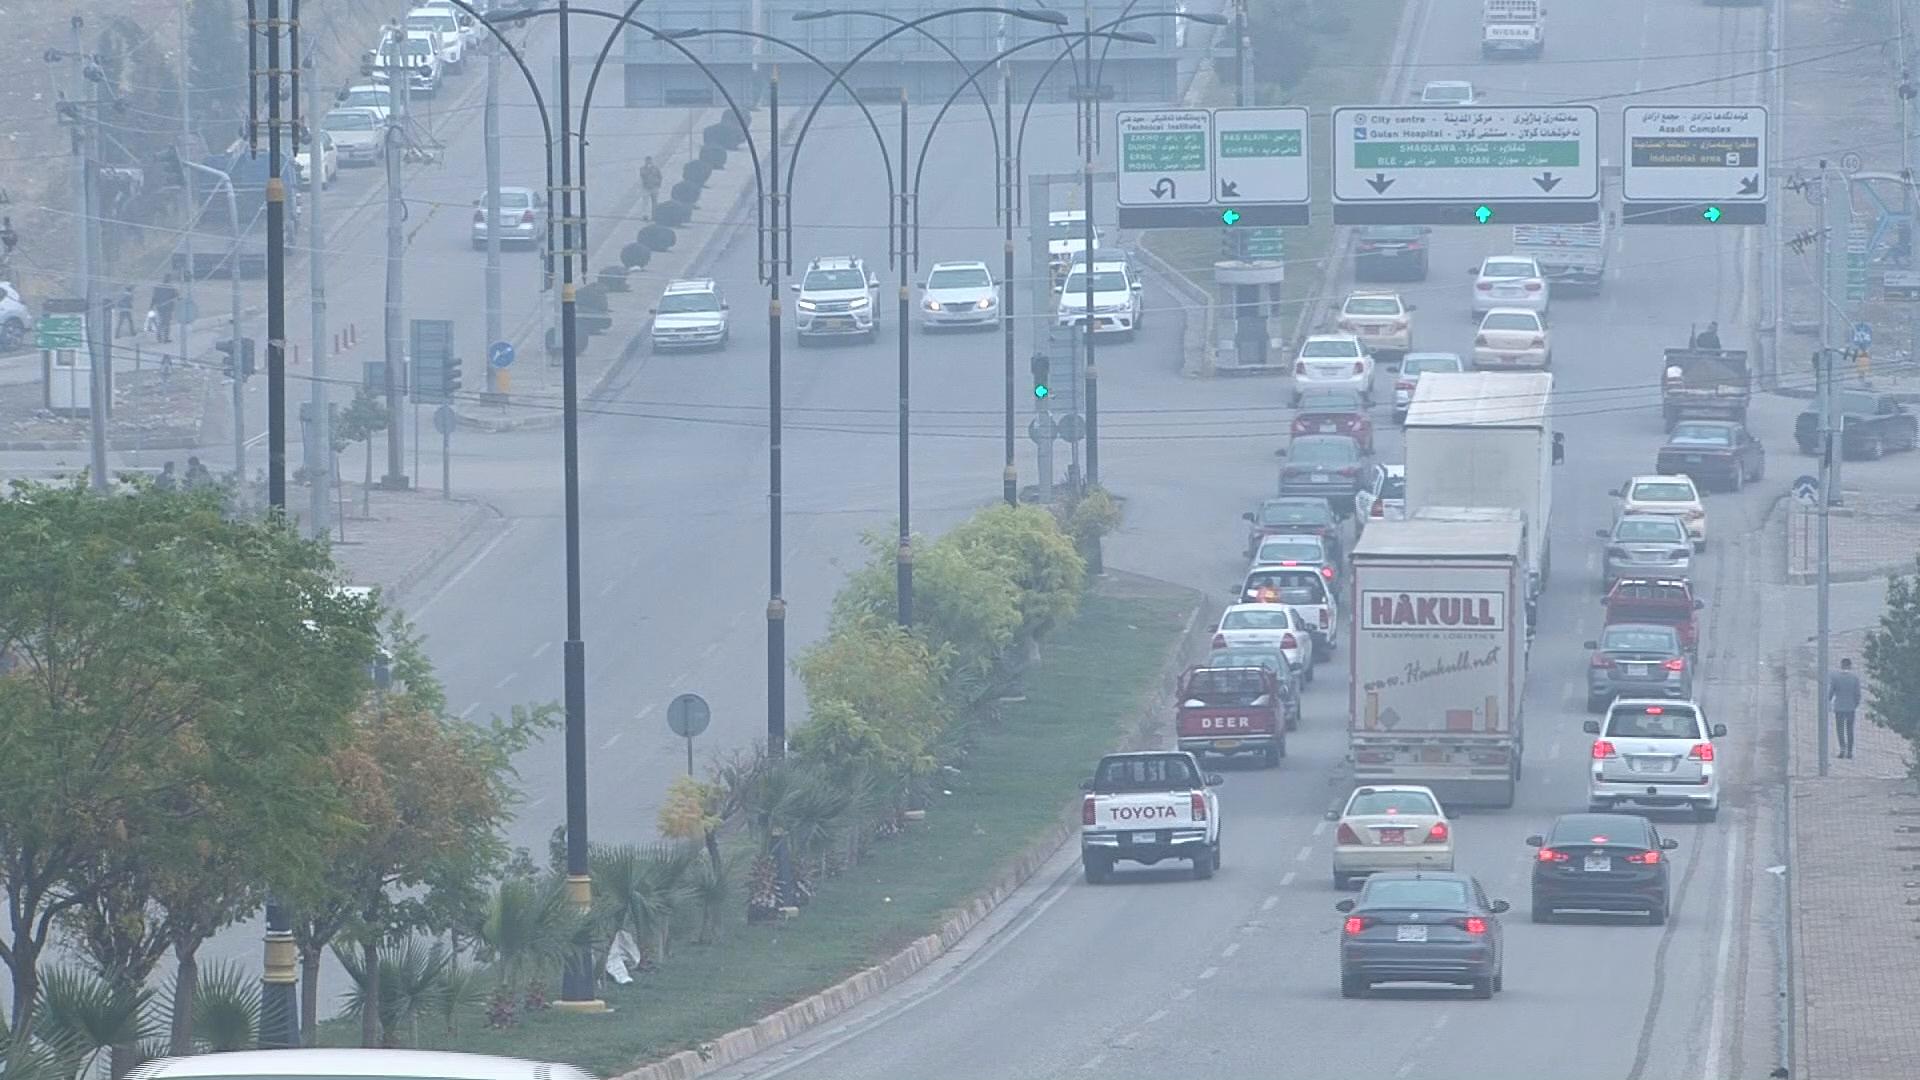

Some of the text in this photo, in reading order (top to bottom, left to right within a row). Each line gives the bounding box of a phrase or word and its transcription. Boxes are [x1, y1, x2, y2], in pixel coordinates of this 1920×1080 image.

[1370, 115, 1390, 125] City
[1127, 122, 1201, 131] Technical Institute
[1658, 125, 1731, 134] Azadi Complex
[1403, 129, 1443, 139] Hospital
[1399, 143, 1457, 153] SHAQLAWA
[1377, 157, 1397, 166] BLE
[1454, 156, 1490, 165] SORAN
[1371, 594, 1495, 625] HÅKULL
[1371, 632, 1431, 640] TRANSPORT
[1443, 632, 1496, 640] LOGISTICS
[1201, 717, 1250, 728] DEER
[1110, 806, 1177, 820] TOYOTA
